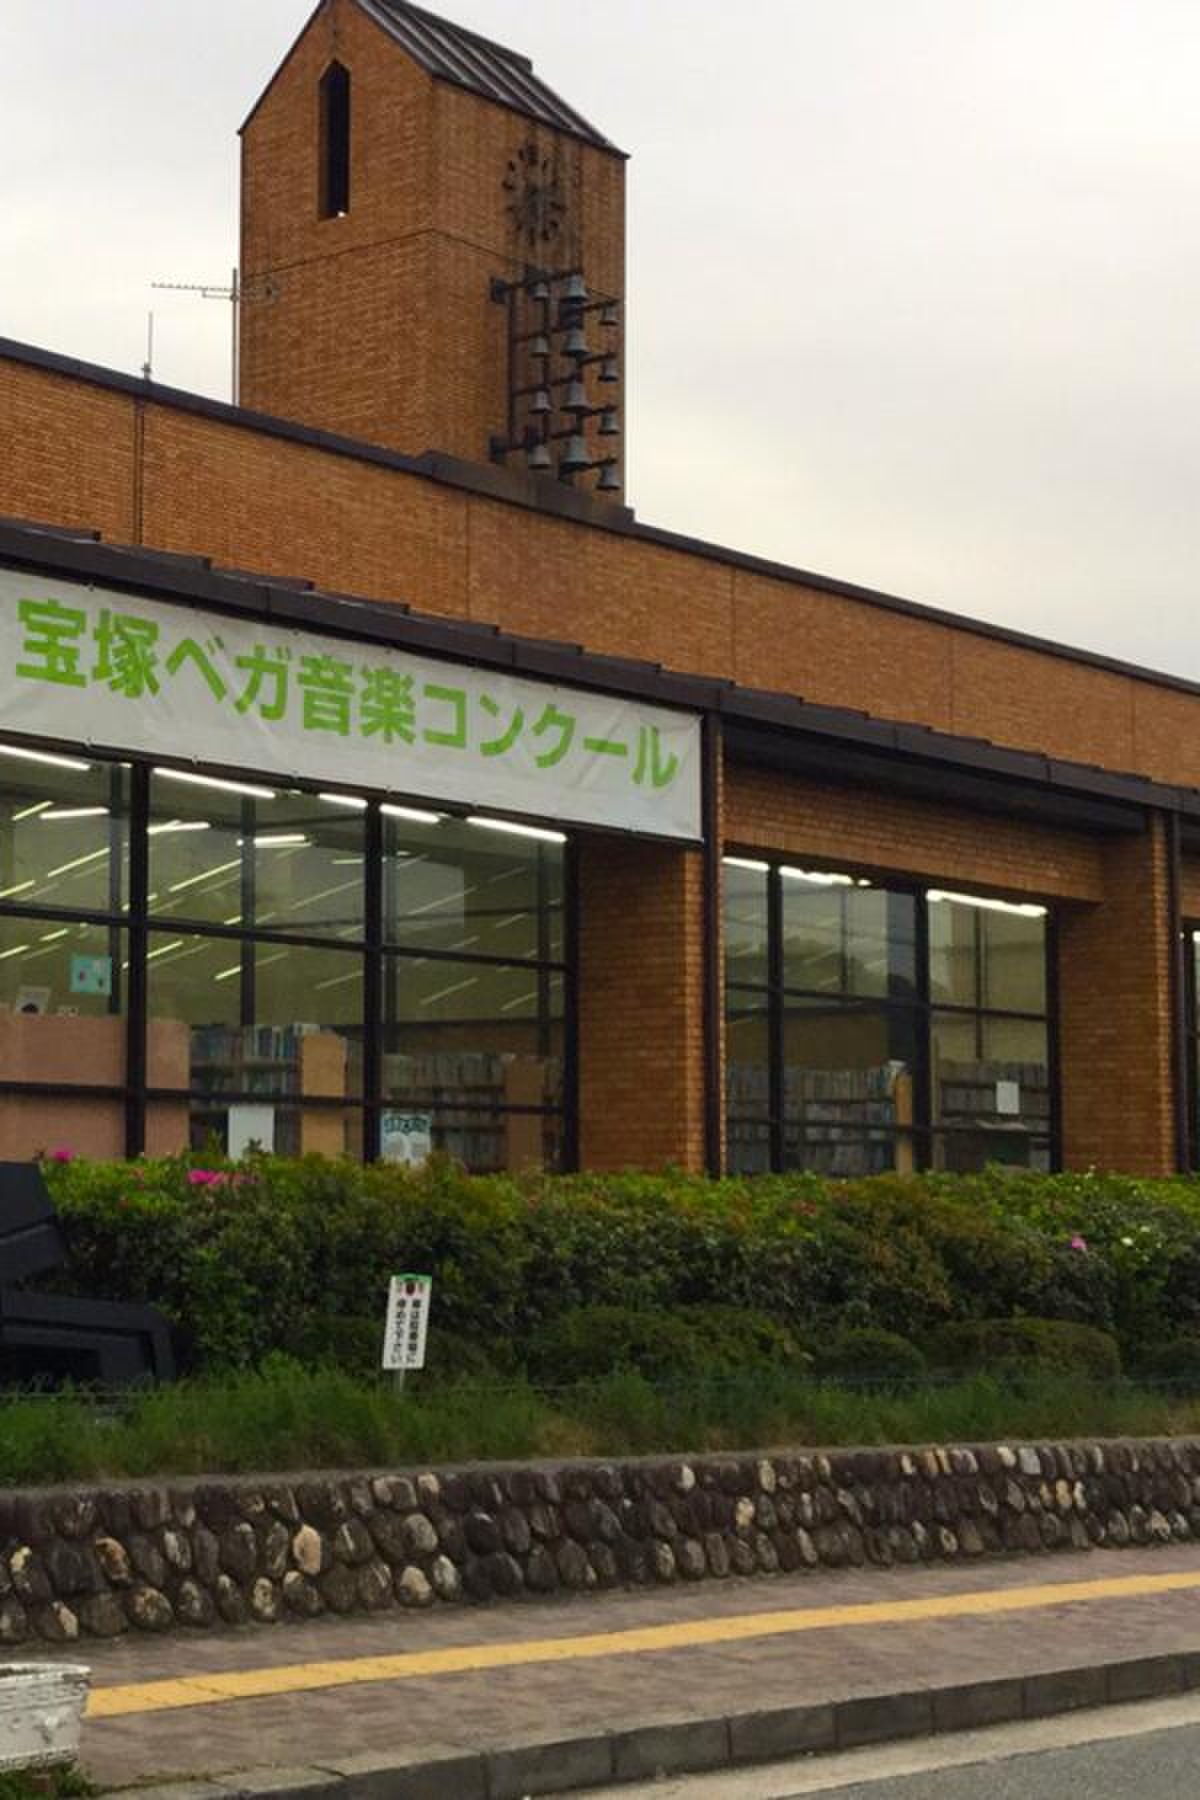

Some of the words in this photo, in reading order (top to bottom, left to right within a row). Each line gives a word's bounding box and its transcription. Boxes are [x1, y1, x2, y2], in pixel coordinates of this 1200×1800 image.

[15, 597, 678, 788] 宝塚ベガ音楽コンクール
